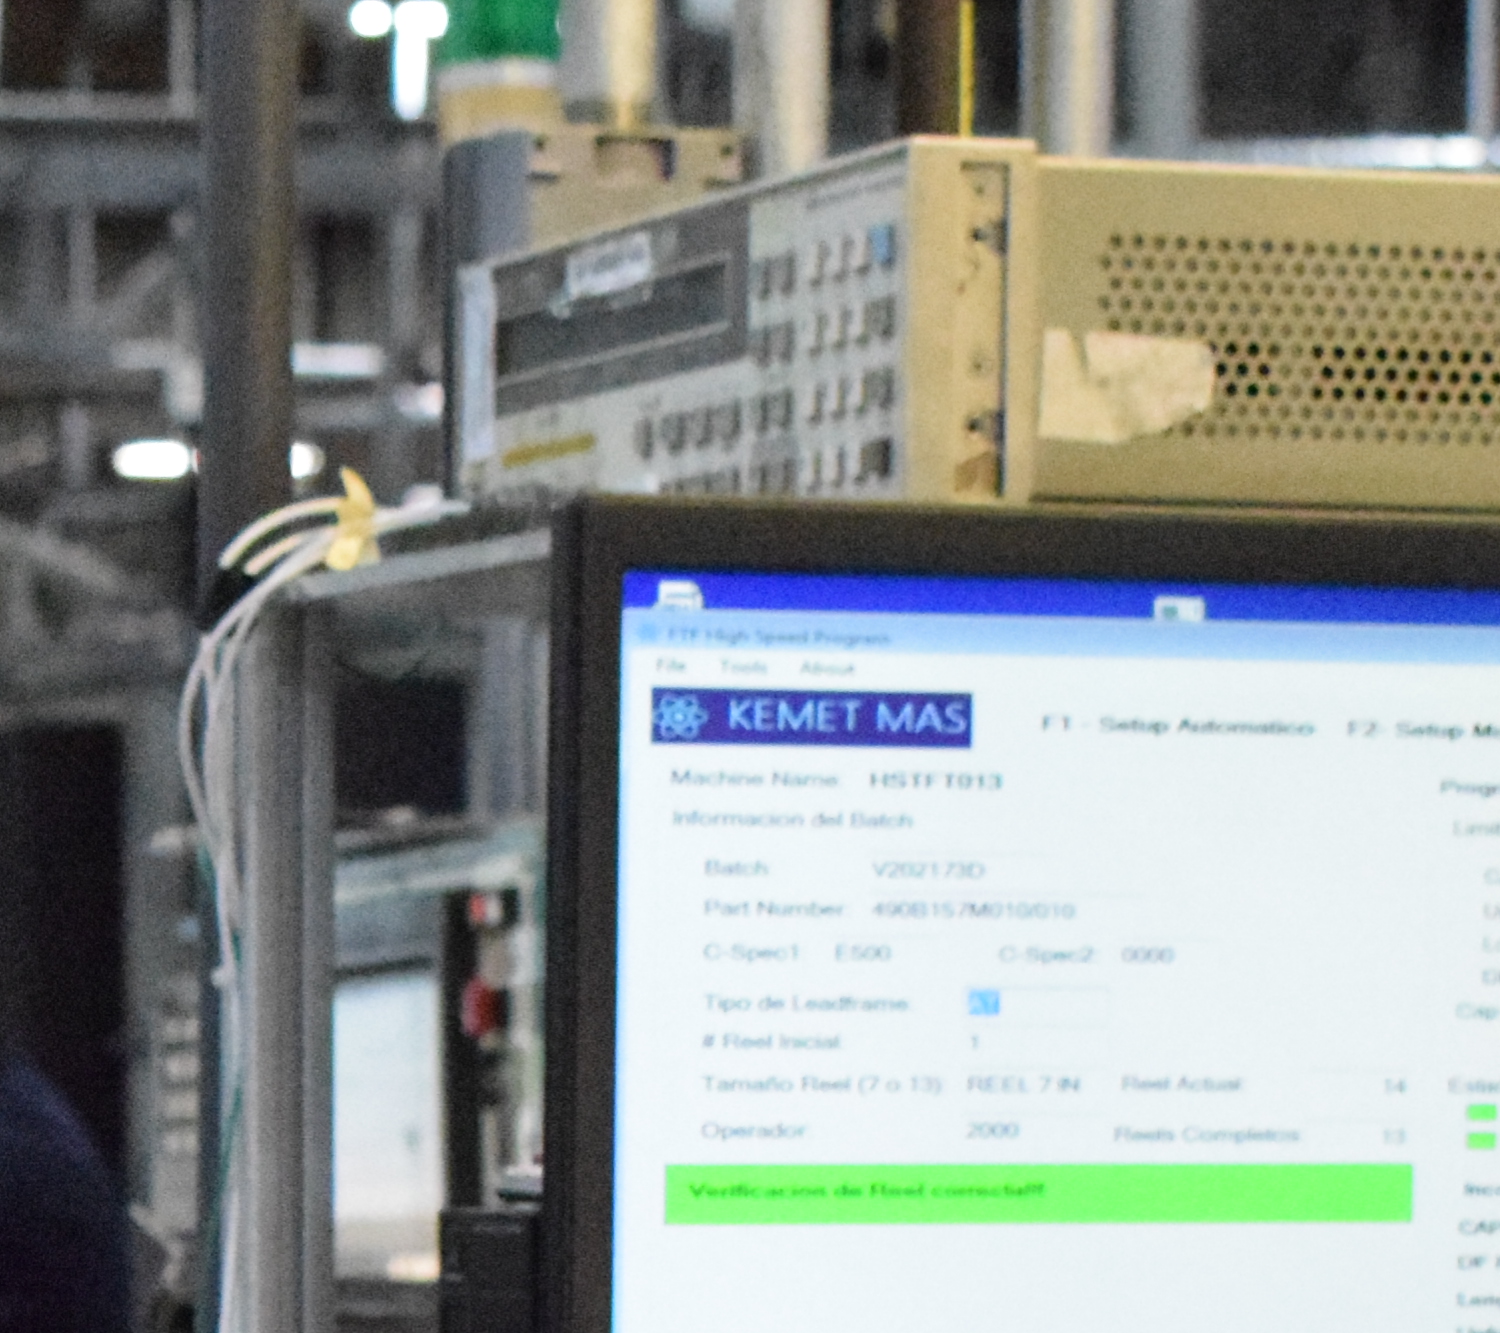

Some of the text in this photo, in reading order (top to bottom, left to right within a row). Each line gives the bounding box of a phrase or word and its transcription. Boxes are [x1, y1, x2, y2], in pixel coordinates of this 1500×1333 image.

[812, 626, 892, 650] Program
[720, 658, 768, 675] Tools
[800, 661, 856, 676] About
[729, 698, 966, 735] KEMET MAS
[1100, 717, 1170, 736] Setup
[1397, 723, 1464, 741] Setup
[670, 769, 764, 786] Machine
[811, 812, 843, 828] del
[850, 812, 914, 829] Batch
[704, 899, 750, 916] Part
[758, 996, 785, 1011] de
[722, 1033, 773, 1049] Reel
[801, 1075, 851, 1092] Reel
